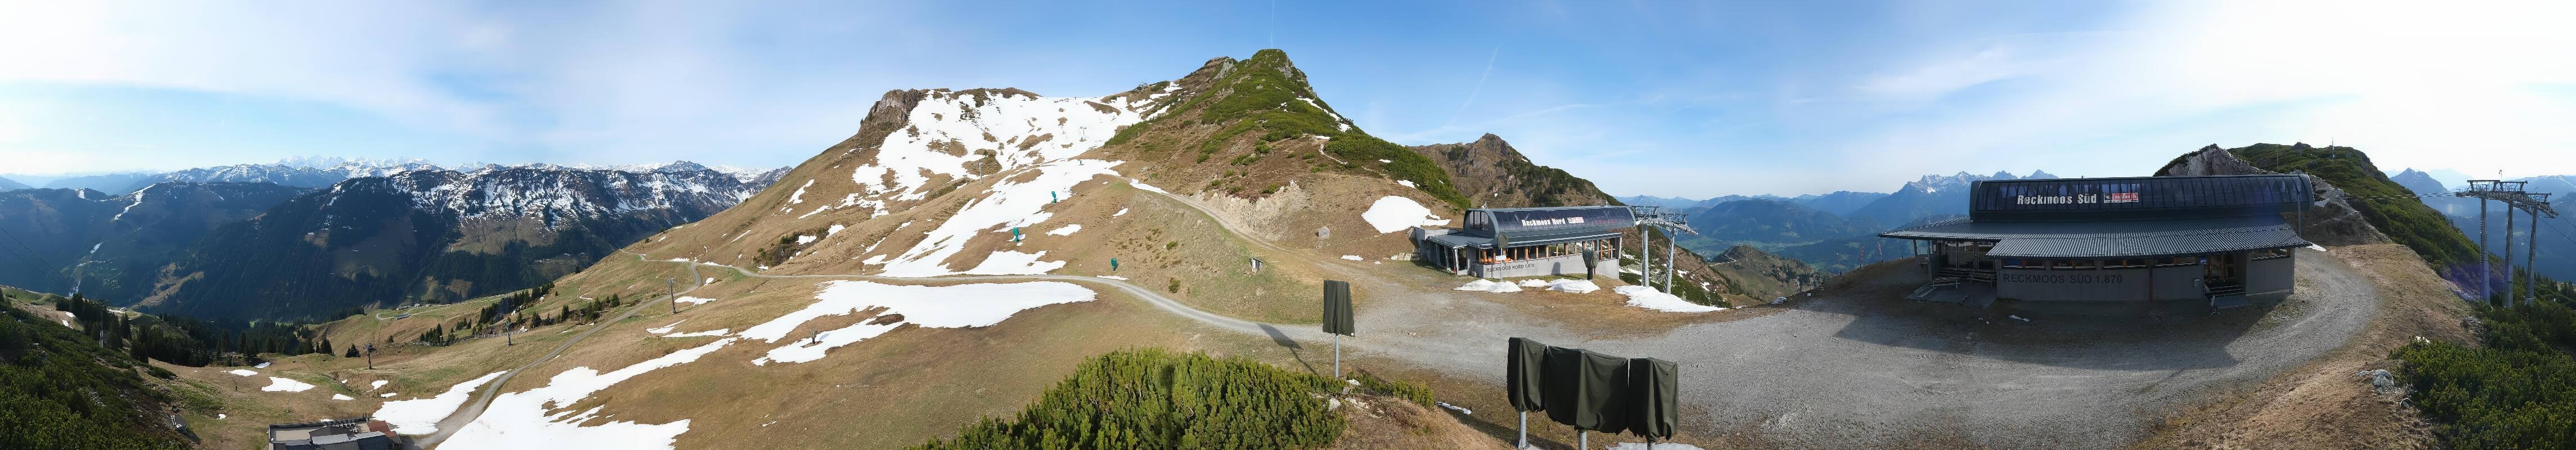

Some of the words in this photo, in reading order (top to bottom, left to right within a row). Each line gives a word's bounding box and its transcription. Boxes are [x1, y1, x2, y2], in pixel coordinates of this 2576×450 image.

[2017, 195, 2073, 204] Reckmoos
[2078, 194, 2097, 204] Süd
[2003, 274, 2065, 283] RECKMOOS
[2070, 274, 2092, 284] SÜD
[2095, 275, 2123, 284] 1.870
